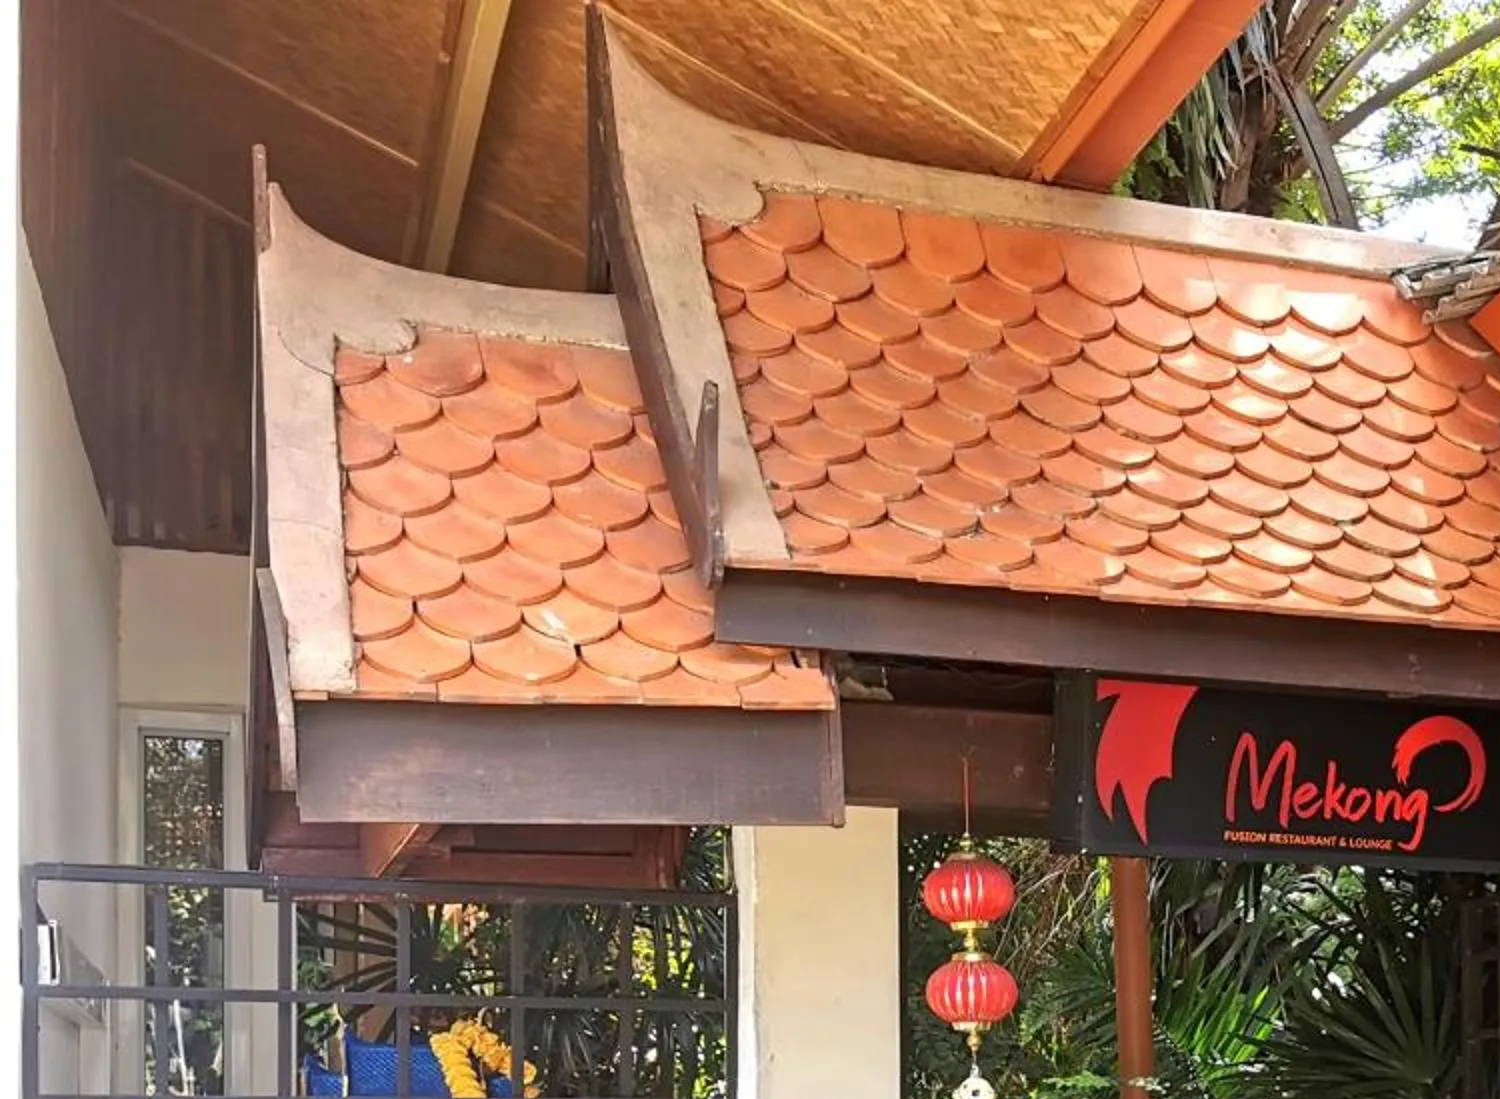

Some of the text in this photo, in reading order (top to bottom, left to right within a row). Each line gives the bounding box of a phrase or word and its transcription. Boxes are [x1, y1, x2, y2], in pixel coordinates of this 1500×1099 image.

[1225, 732, 1428, 850] Mekong
[1224, 831, 1392, 850] FUSION RESTAURANT & LOUNGE
